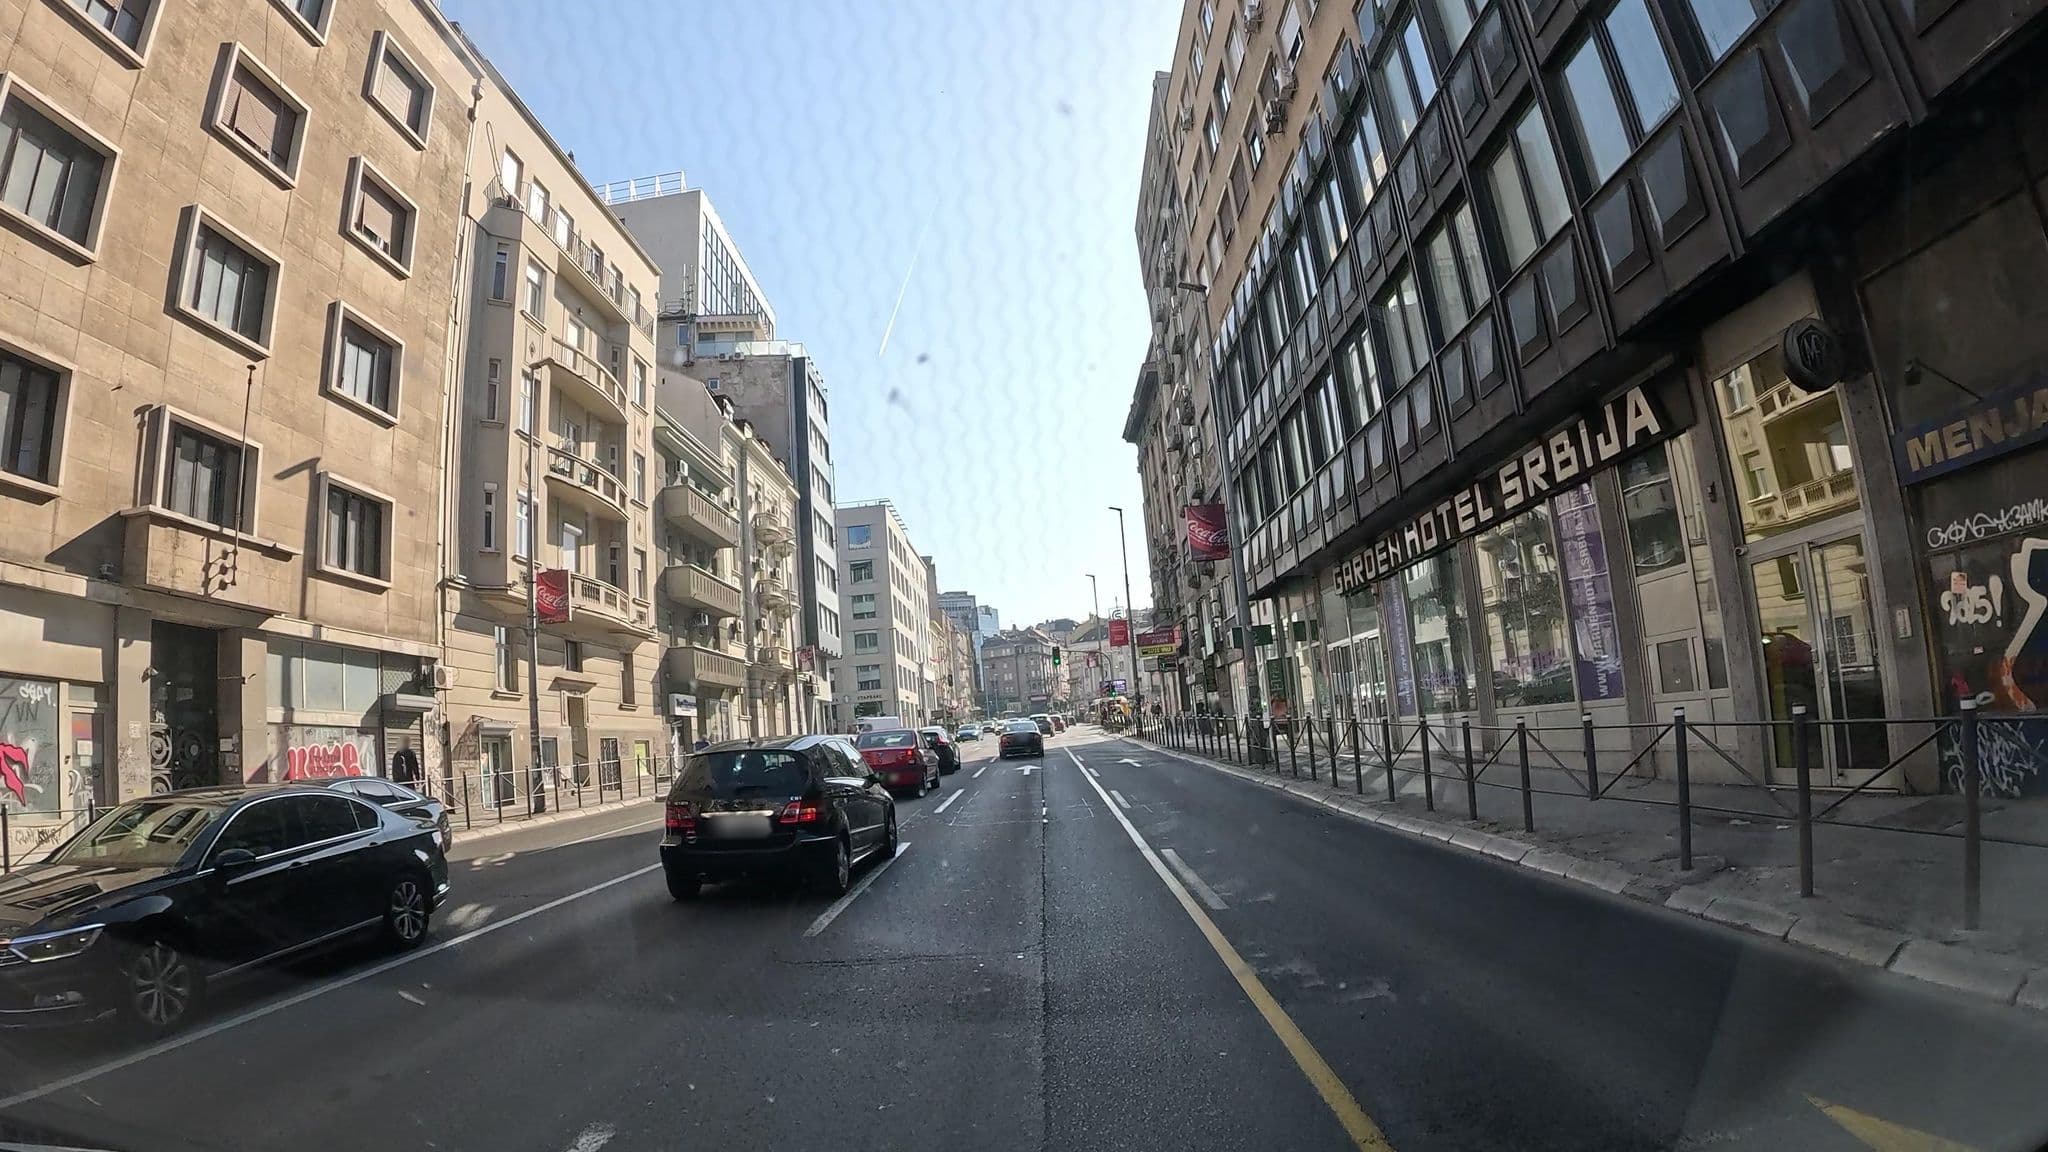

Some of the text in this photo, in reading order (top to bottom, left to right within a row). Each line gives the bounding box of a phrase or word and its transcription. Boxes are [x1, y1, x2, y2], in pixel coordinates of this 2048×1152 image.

[1333, 386, 1661, 595] GARDEN HOTEL SRBIJA
